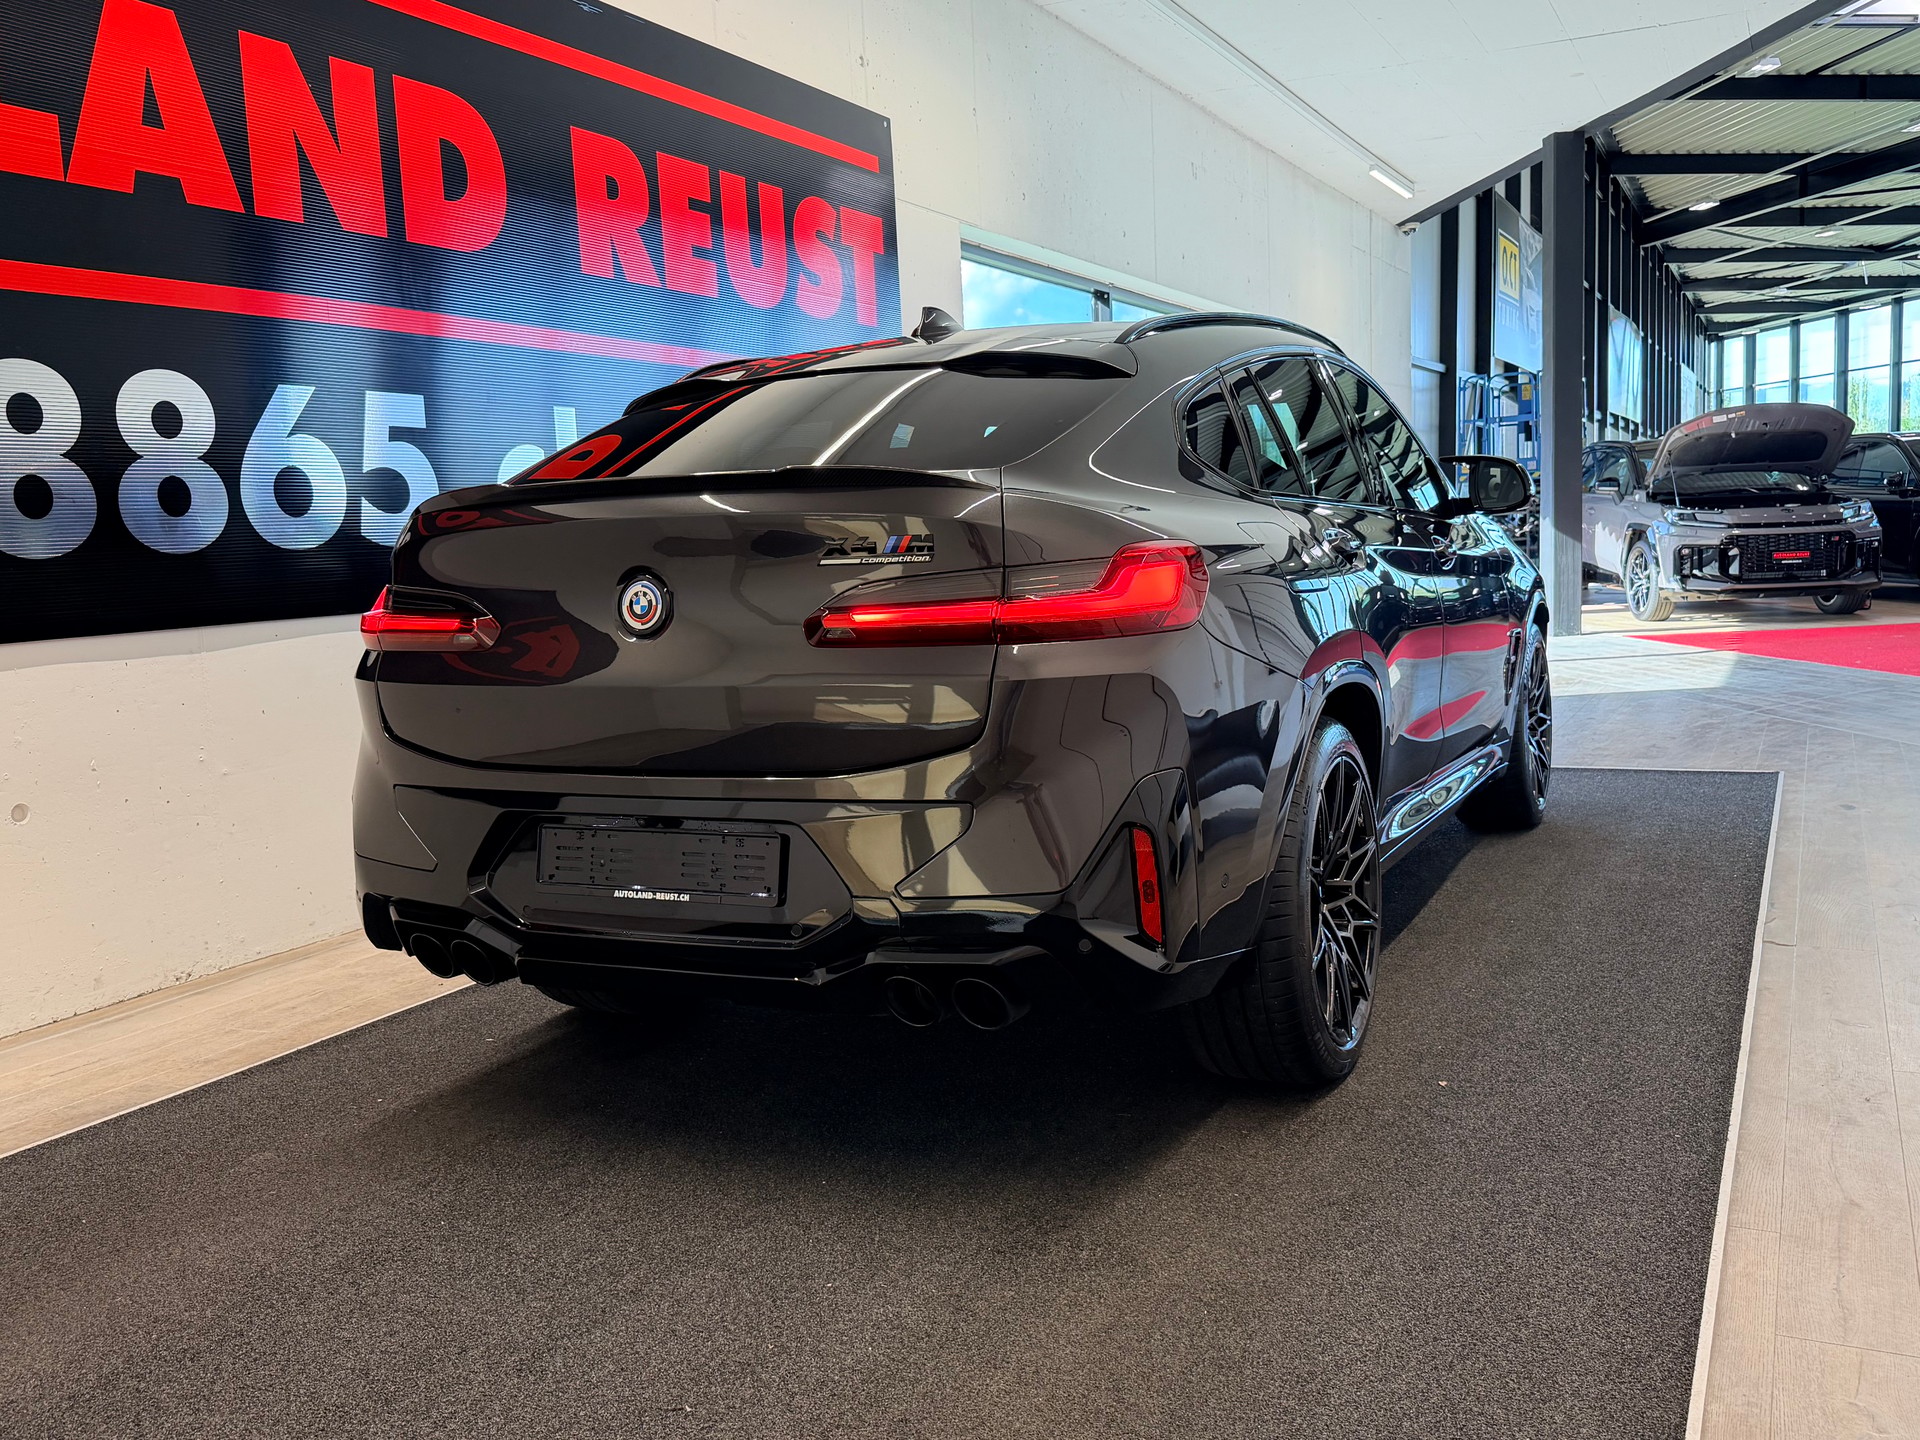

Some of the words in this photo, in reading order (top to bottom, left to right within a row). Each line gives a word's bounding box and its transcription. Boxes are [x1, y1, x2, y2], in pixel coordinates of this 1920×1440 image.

[0, 0, 507, 254] AND
[570, 125, 885, 328] REUST
[822, 536, 878, 557] X4
[861, 555, 930, 564] competition
[613, 889, 690, 902] AUTOLAND-REUST.CH
